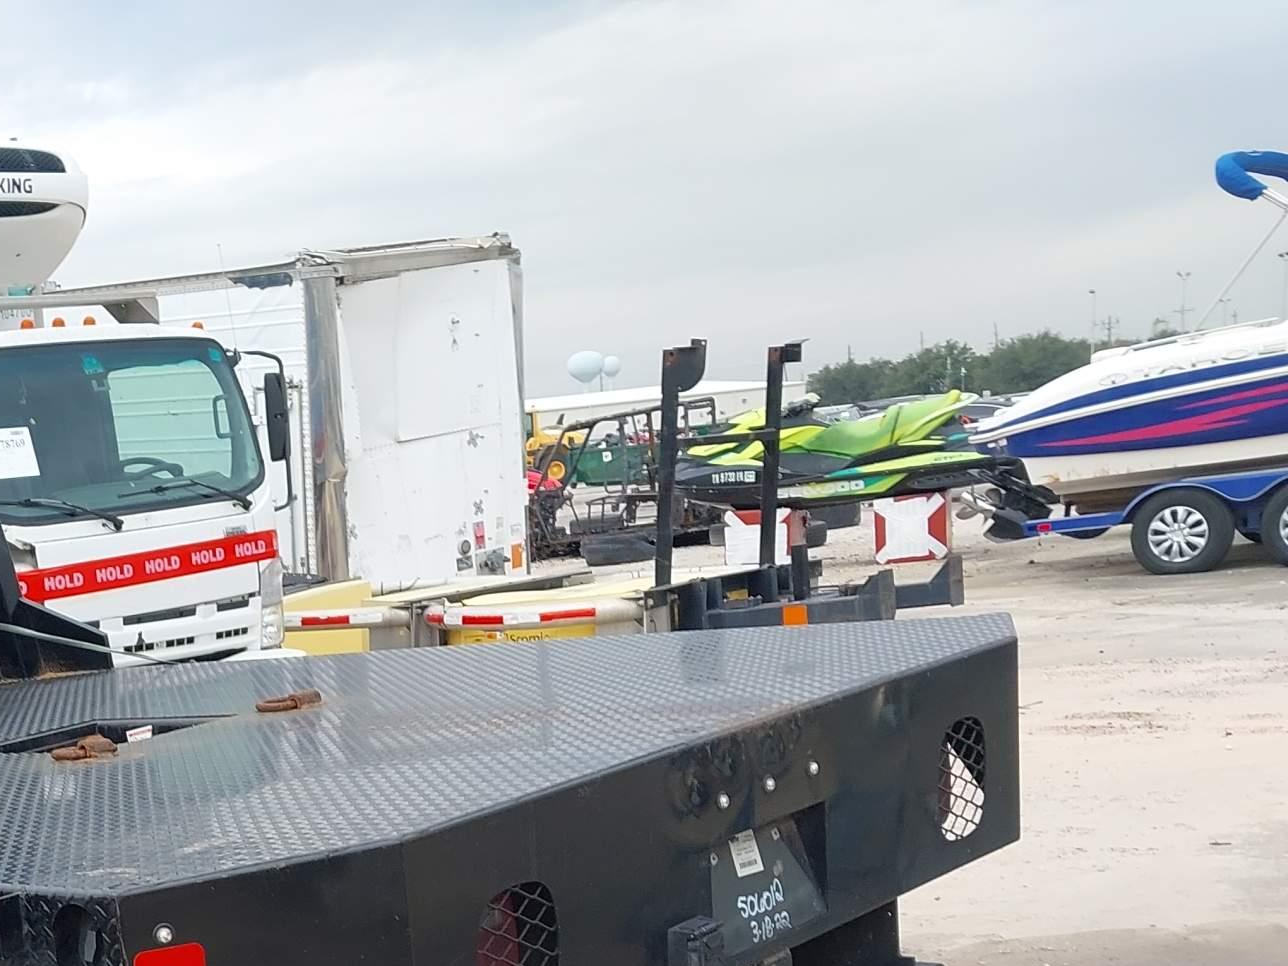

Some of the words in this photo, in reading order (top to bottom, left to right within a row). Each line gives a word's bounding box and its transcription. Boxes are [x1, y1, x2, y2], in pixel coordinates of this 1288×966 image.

[44, 572, 84, 592] HOLD
[96, 564, 134, 584] HOLD
[145, 555, 181, 574] HOLD
[191, 547, 226, 566] HOLD
[235, 540, 267, 559] HOLD
